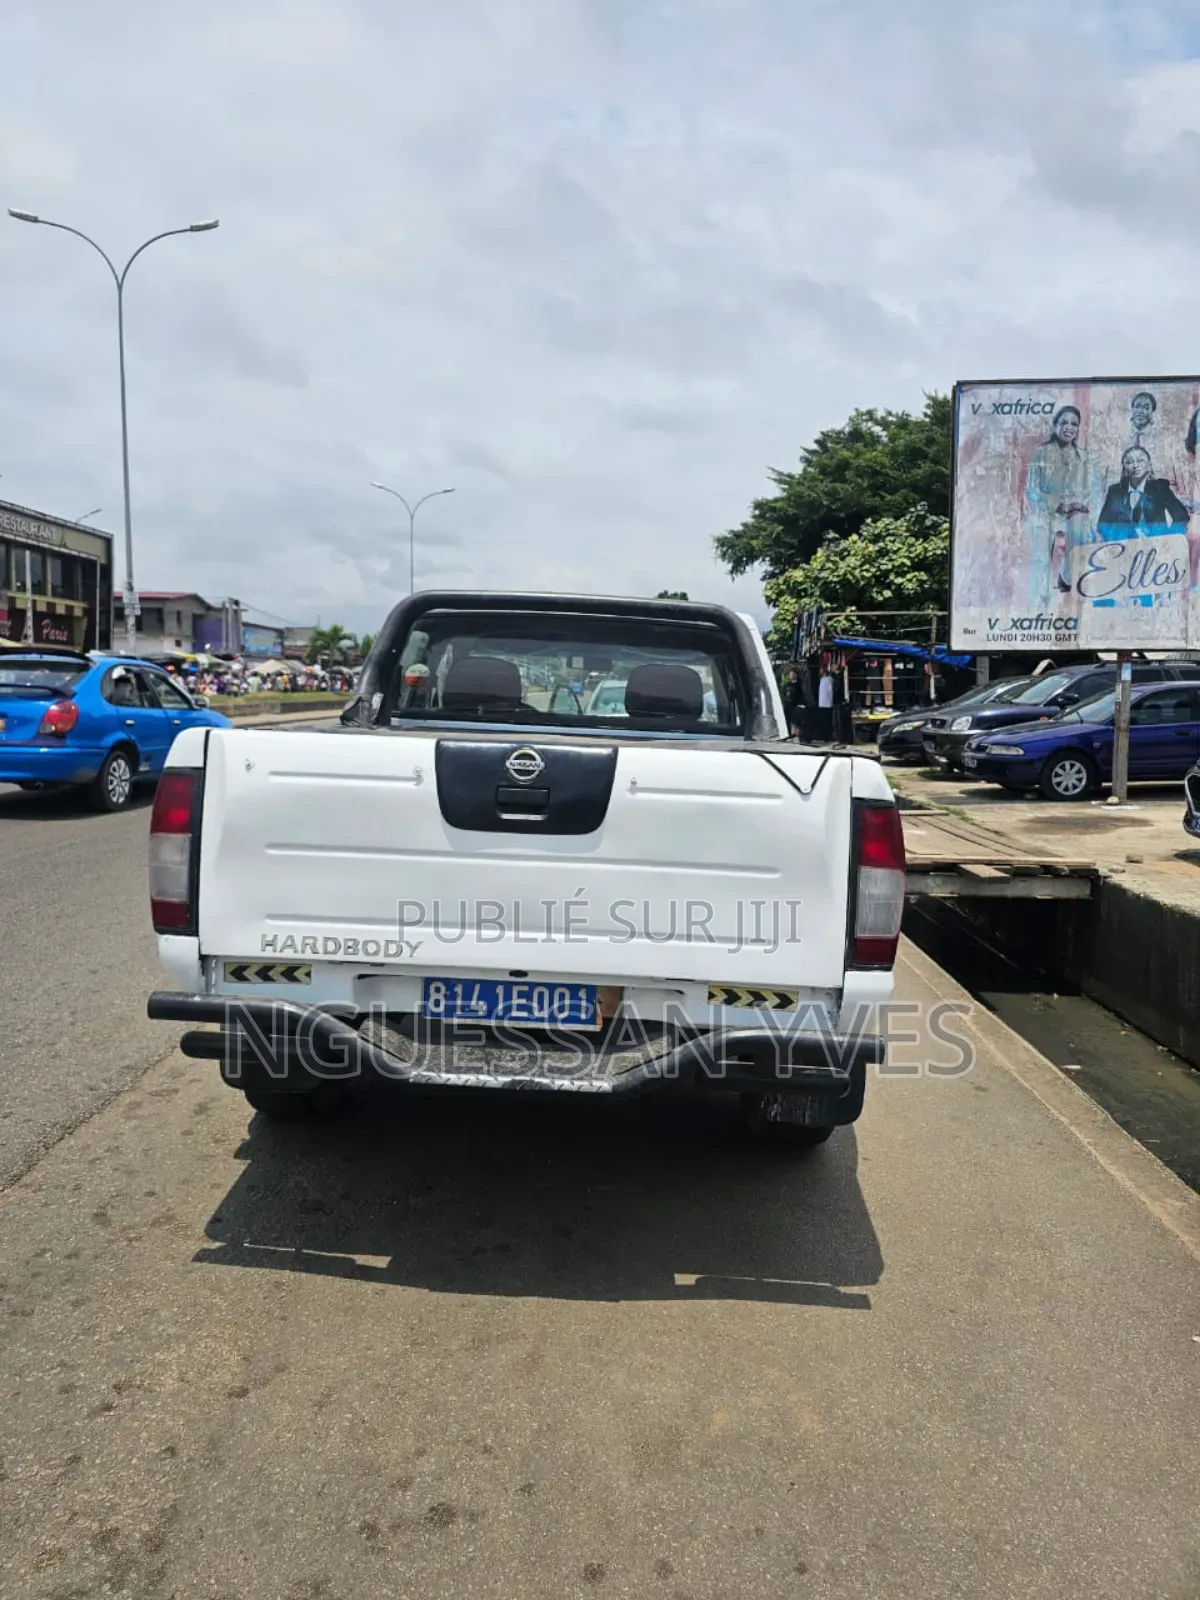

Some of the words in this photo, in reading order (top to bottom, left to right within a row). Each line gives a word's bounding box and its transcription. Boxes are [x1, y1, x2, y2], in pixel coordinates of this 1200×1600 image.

[970, 398, 1056, 416] vxafrica
[1076, 543, 1186, 599] Elles
[987, 613, 1079, 631] vxafrica
[986, 633, 1017, 642] LUNDI
[1019, 632, 1052, 642] 20H30
[1054, 632, 1080, 642] GMT
[508, 760, 542, 770] NISSAN
[260, 933, 425, 959] HARDBODY
